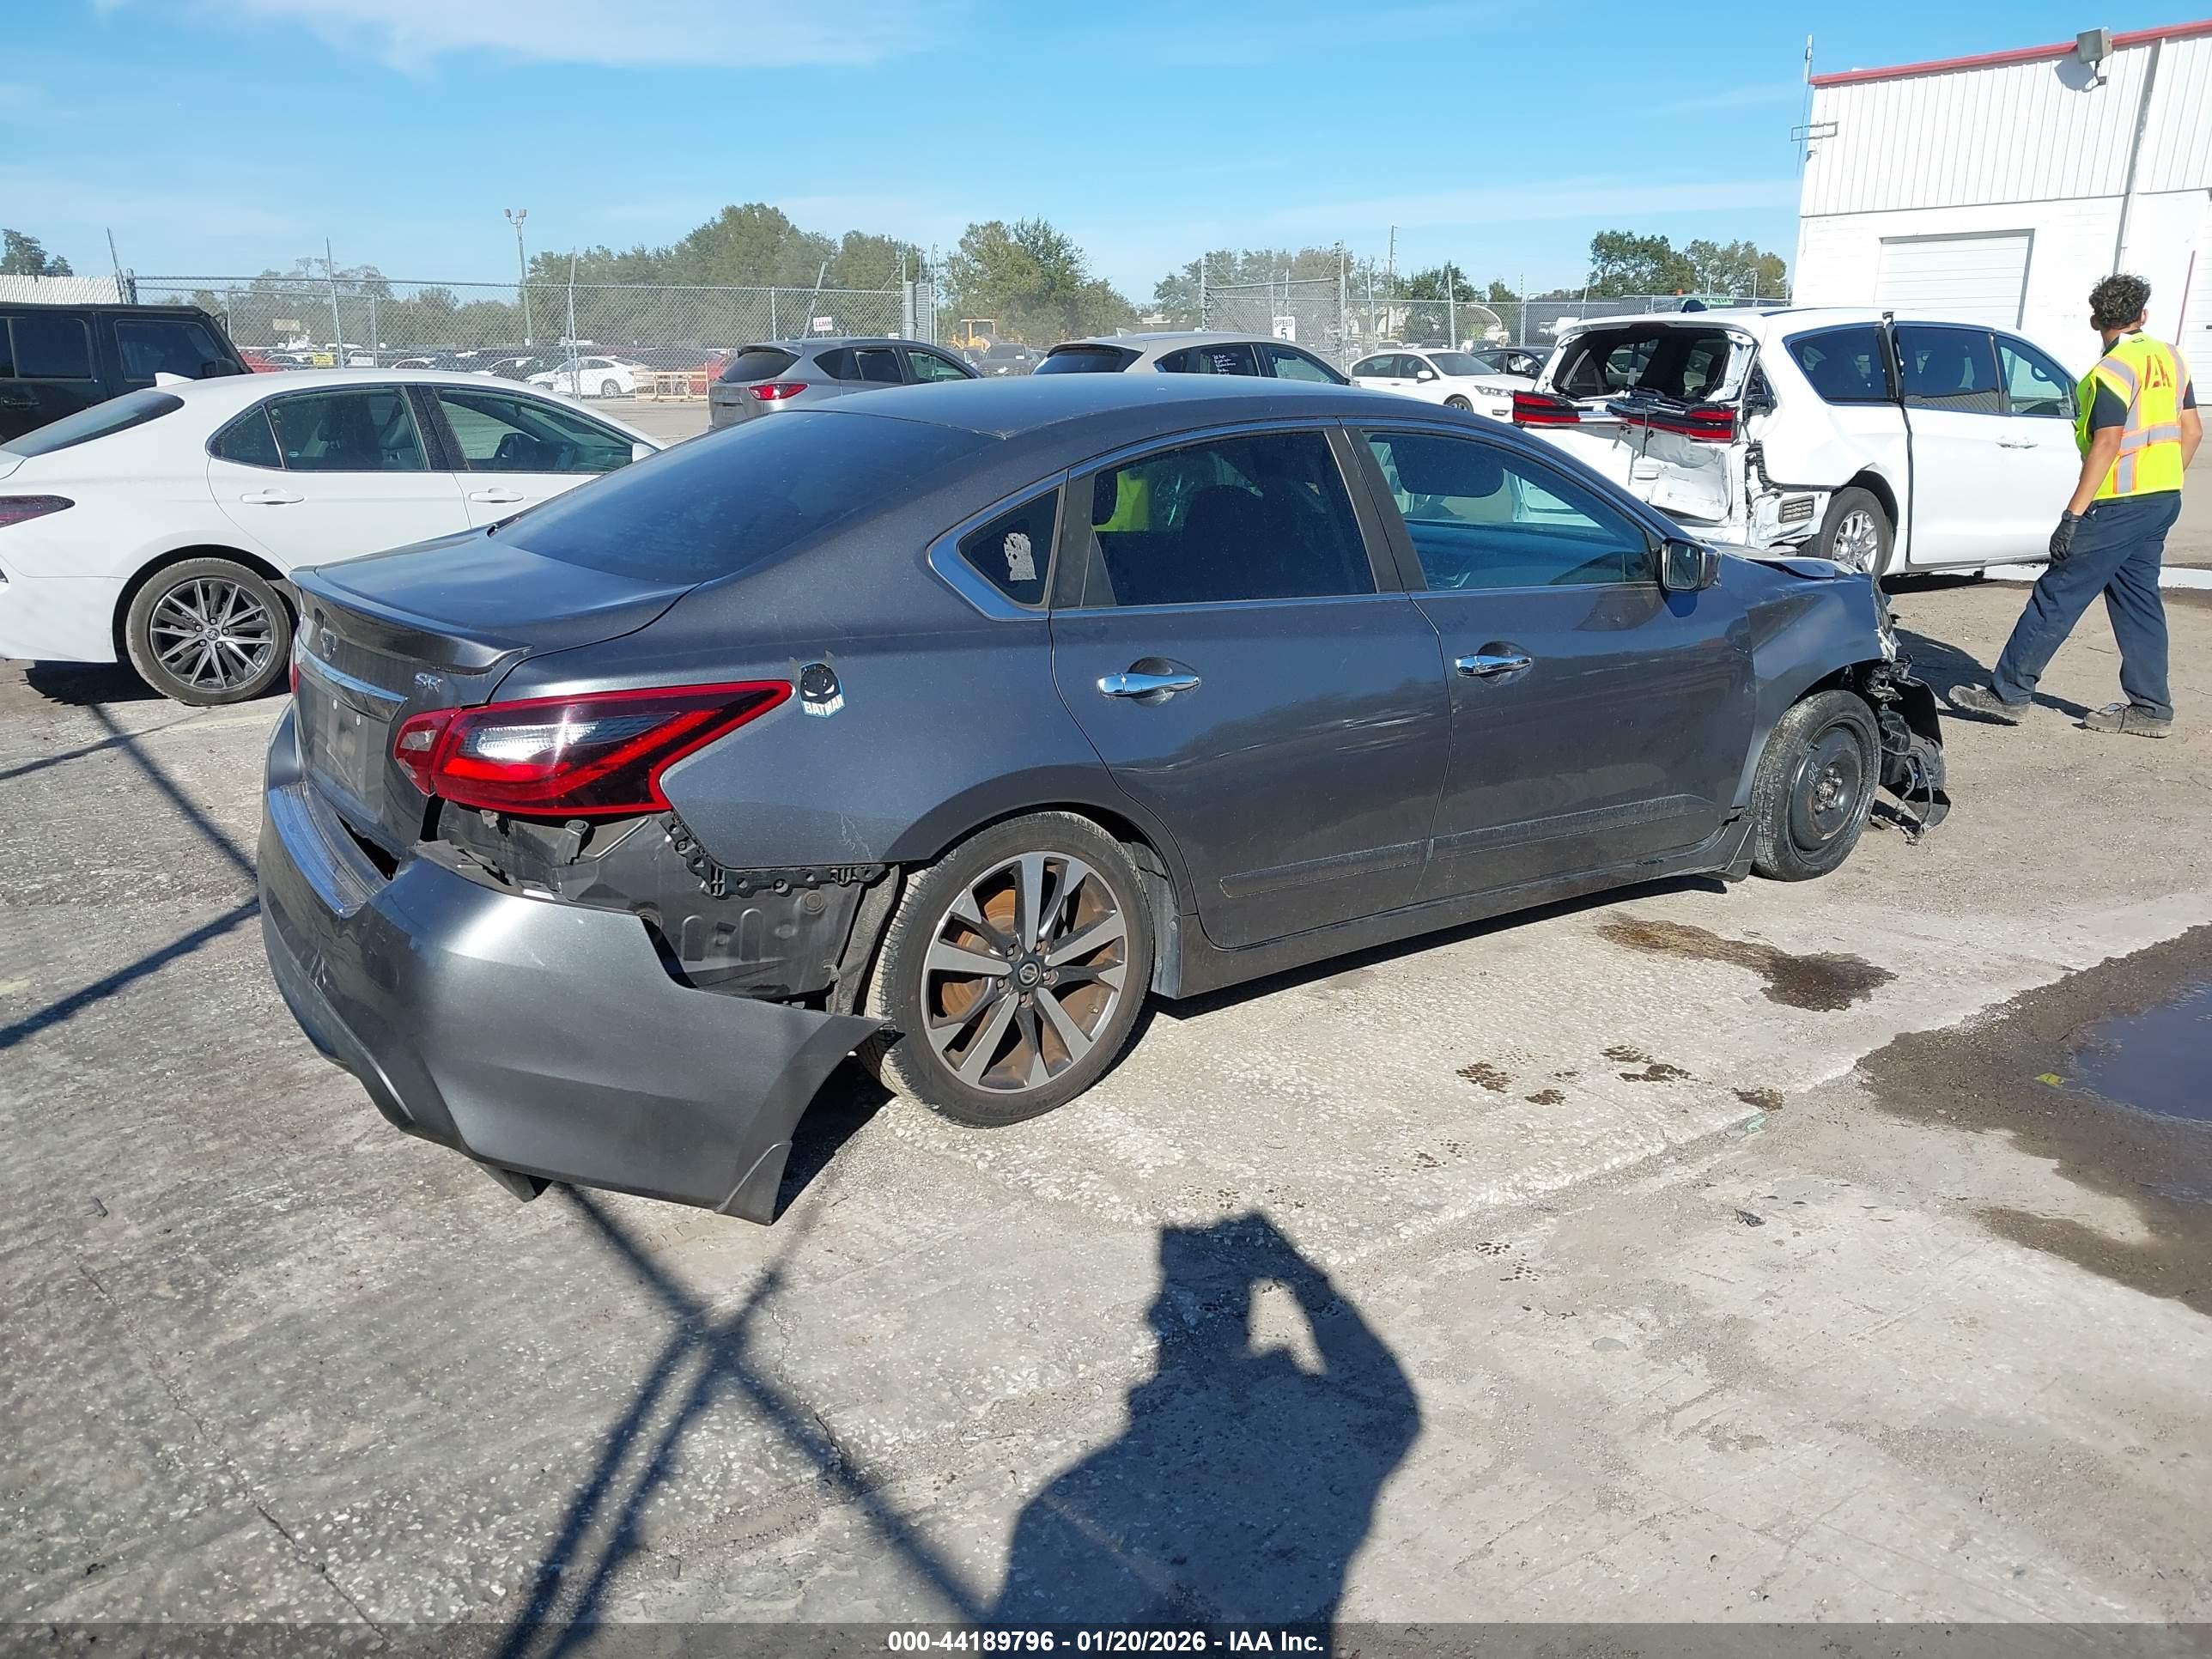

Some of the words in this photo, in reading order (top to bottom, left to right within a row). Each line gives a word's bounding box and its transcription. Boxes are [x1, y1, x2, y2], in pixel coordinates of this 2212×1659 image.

[1274, 319, 1293, 327] SPEED
[1280, 327, 1287, 341] 5
[414, 672, 443, 694] SR
[802, 694, 844, 716] BATMAN
